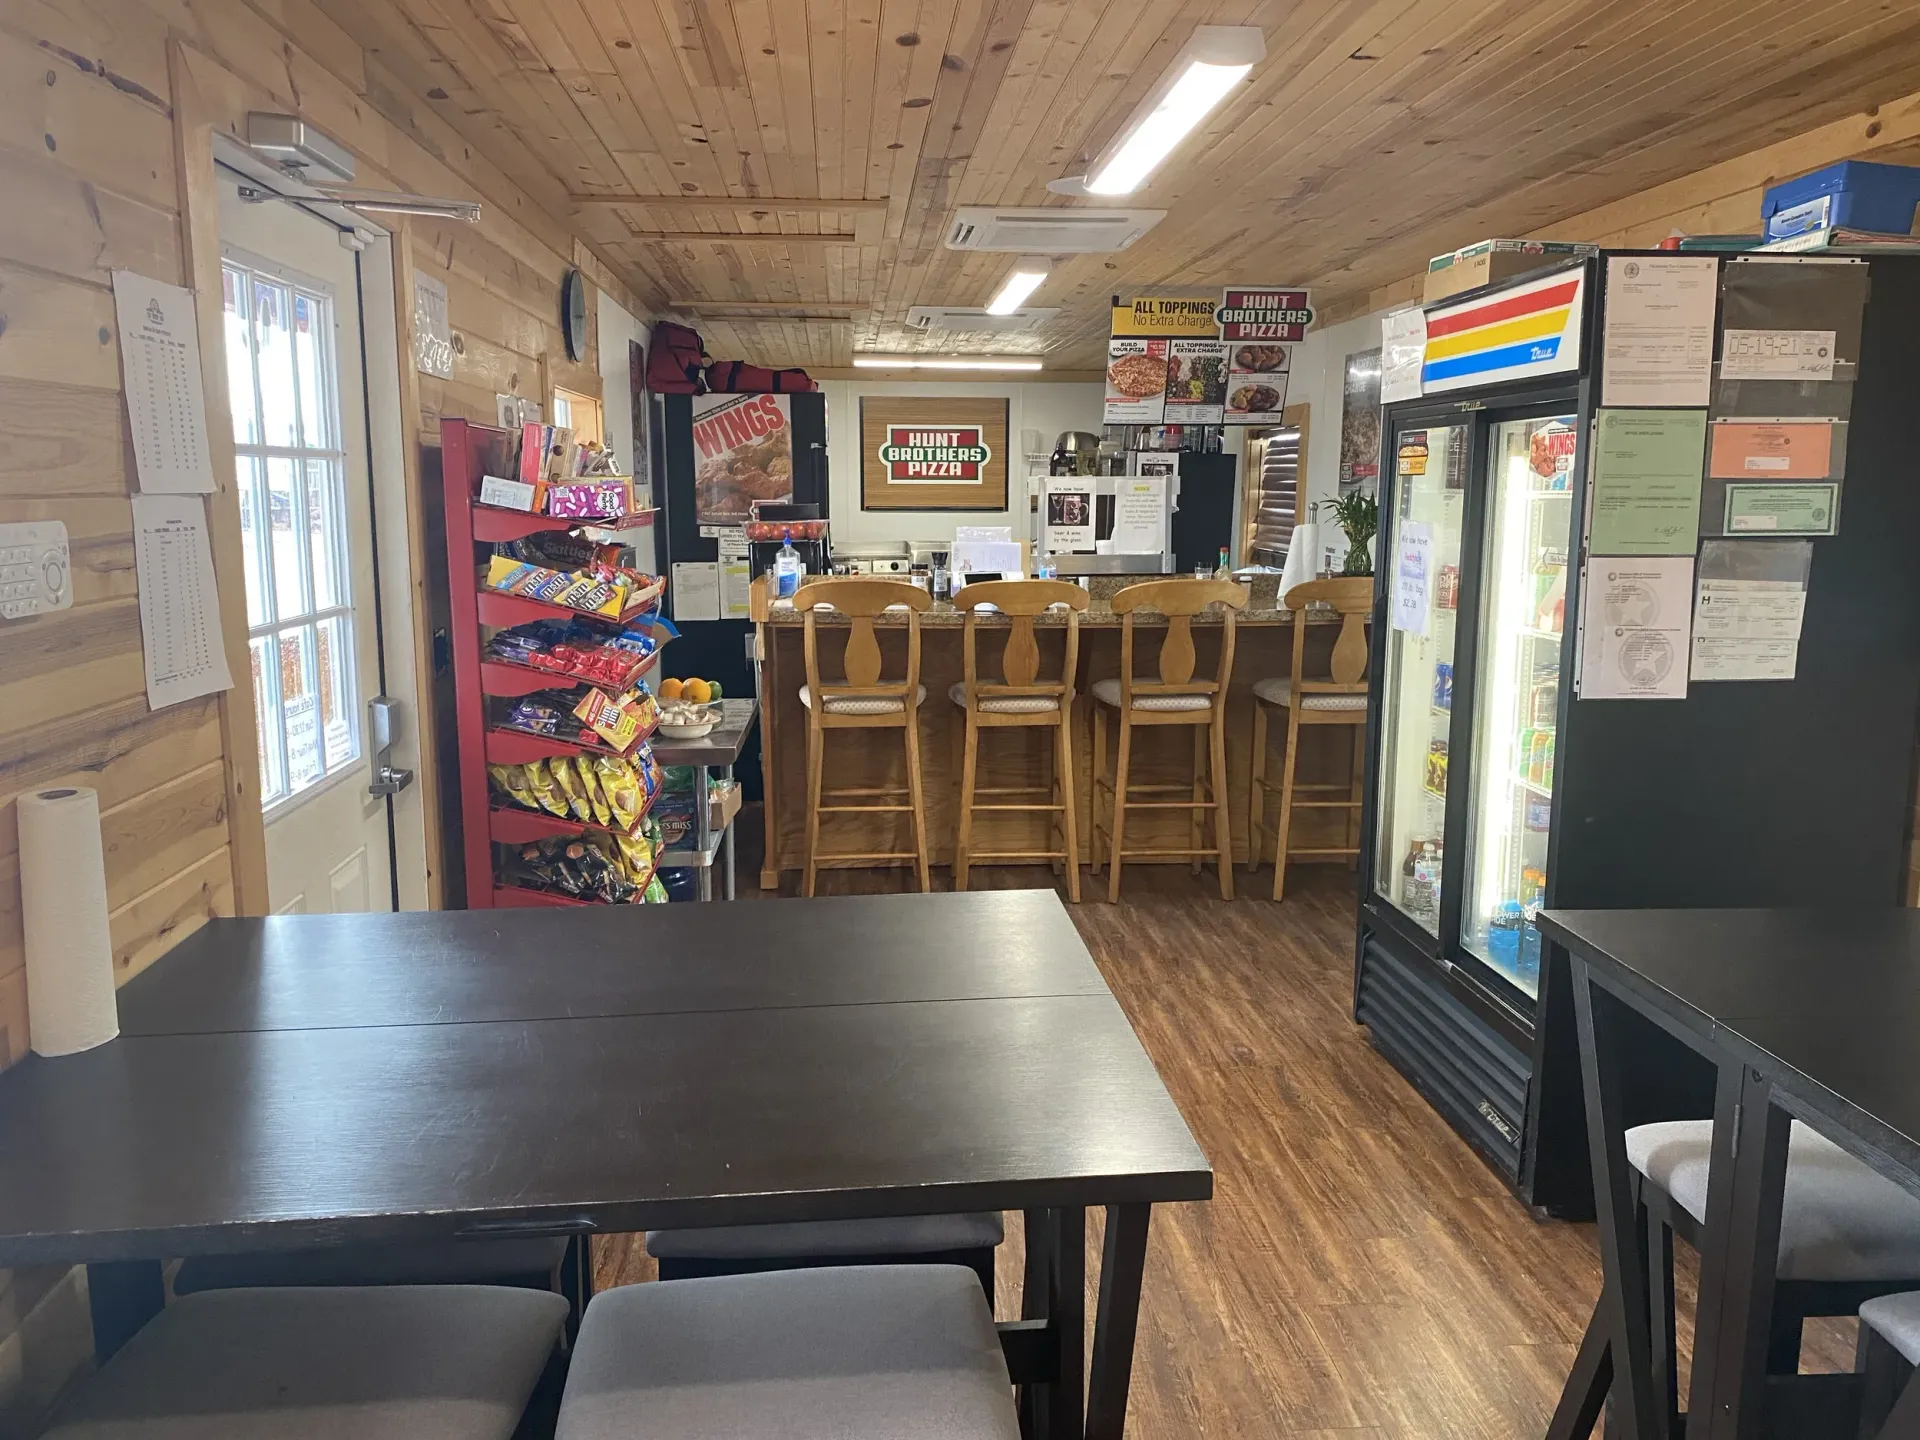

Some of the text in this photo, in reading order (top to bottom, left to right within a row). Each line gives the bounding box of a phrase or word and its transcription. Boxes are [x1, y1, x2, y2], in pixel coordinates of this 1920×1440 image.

[1135, 301, 1216, 315] ALL TOPPINGS
[1242, 295, 1290, 309] HUNT
[1134, 315, 1212, 328] No Extra Charge
[1222, 309, 1308, 323] BROTHERS
[1239, 324, 1290, 338] PIZZA
[1530, 347, 1555, 360] True
[694, 394, 784, 459] WINGS
[908, 433, 960, 446] HUNT
[1549, 433, 1575, 456] WINGS
[888, 448, 982, 461] BROTHERS
[908, 462, 962, 476] PIZZA
[543, 542, 592, 560] Skittles
[1478, 1100, 1512, 1142] True
